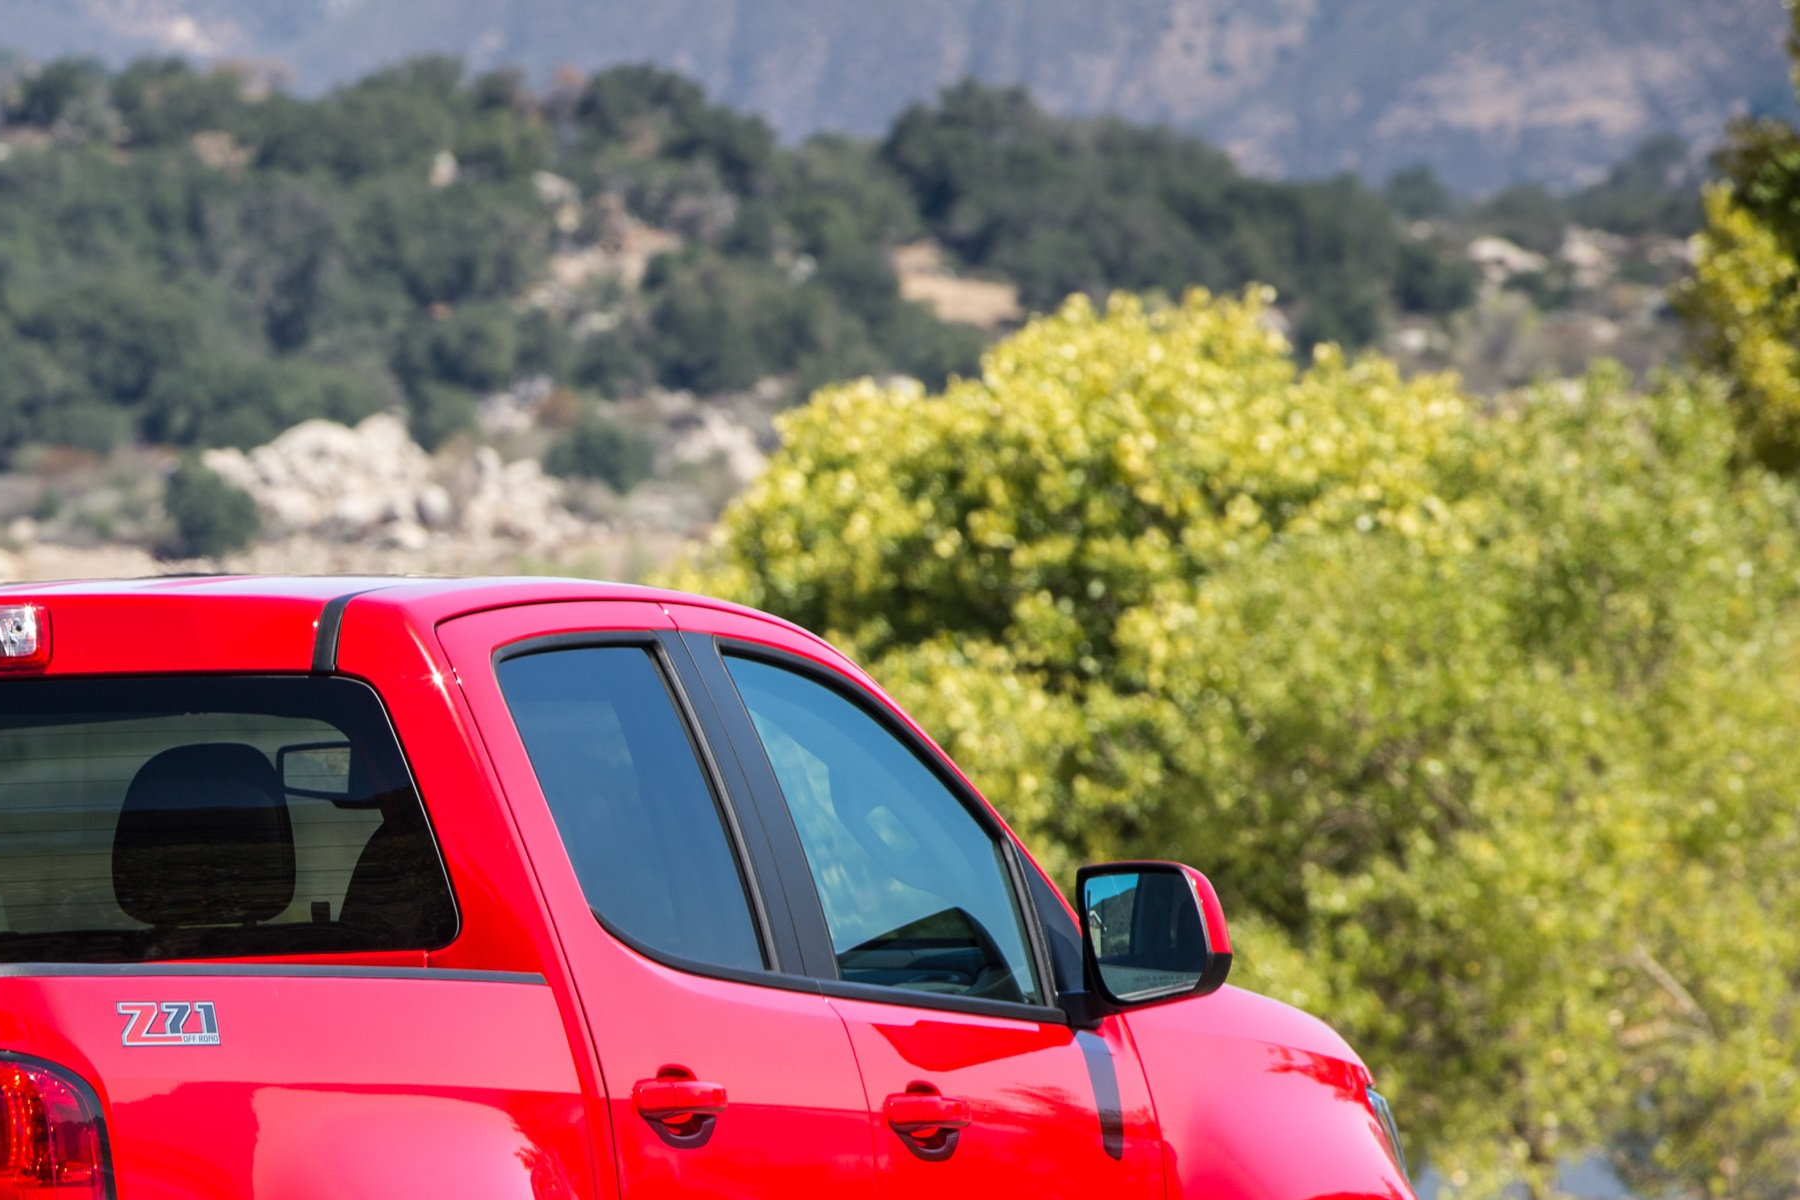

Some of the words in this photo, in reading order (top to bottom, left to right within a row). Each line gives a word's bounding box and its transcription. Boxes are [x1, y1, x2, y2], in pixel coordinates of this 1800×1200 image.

[116, 1001, 220, 1046] Z71
[183, 1035, 198, 1043] OFF
[198, 1035, 219, 1043] ROAD
